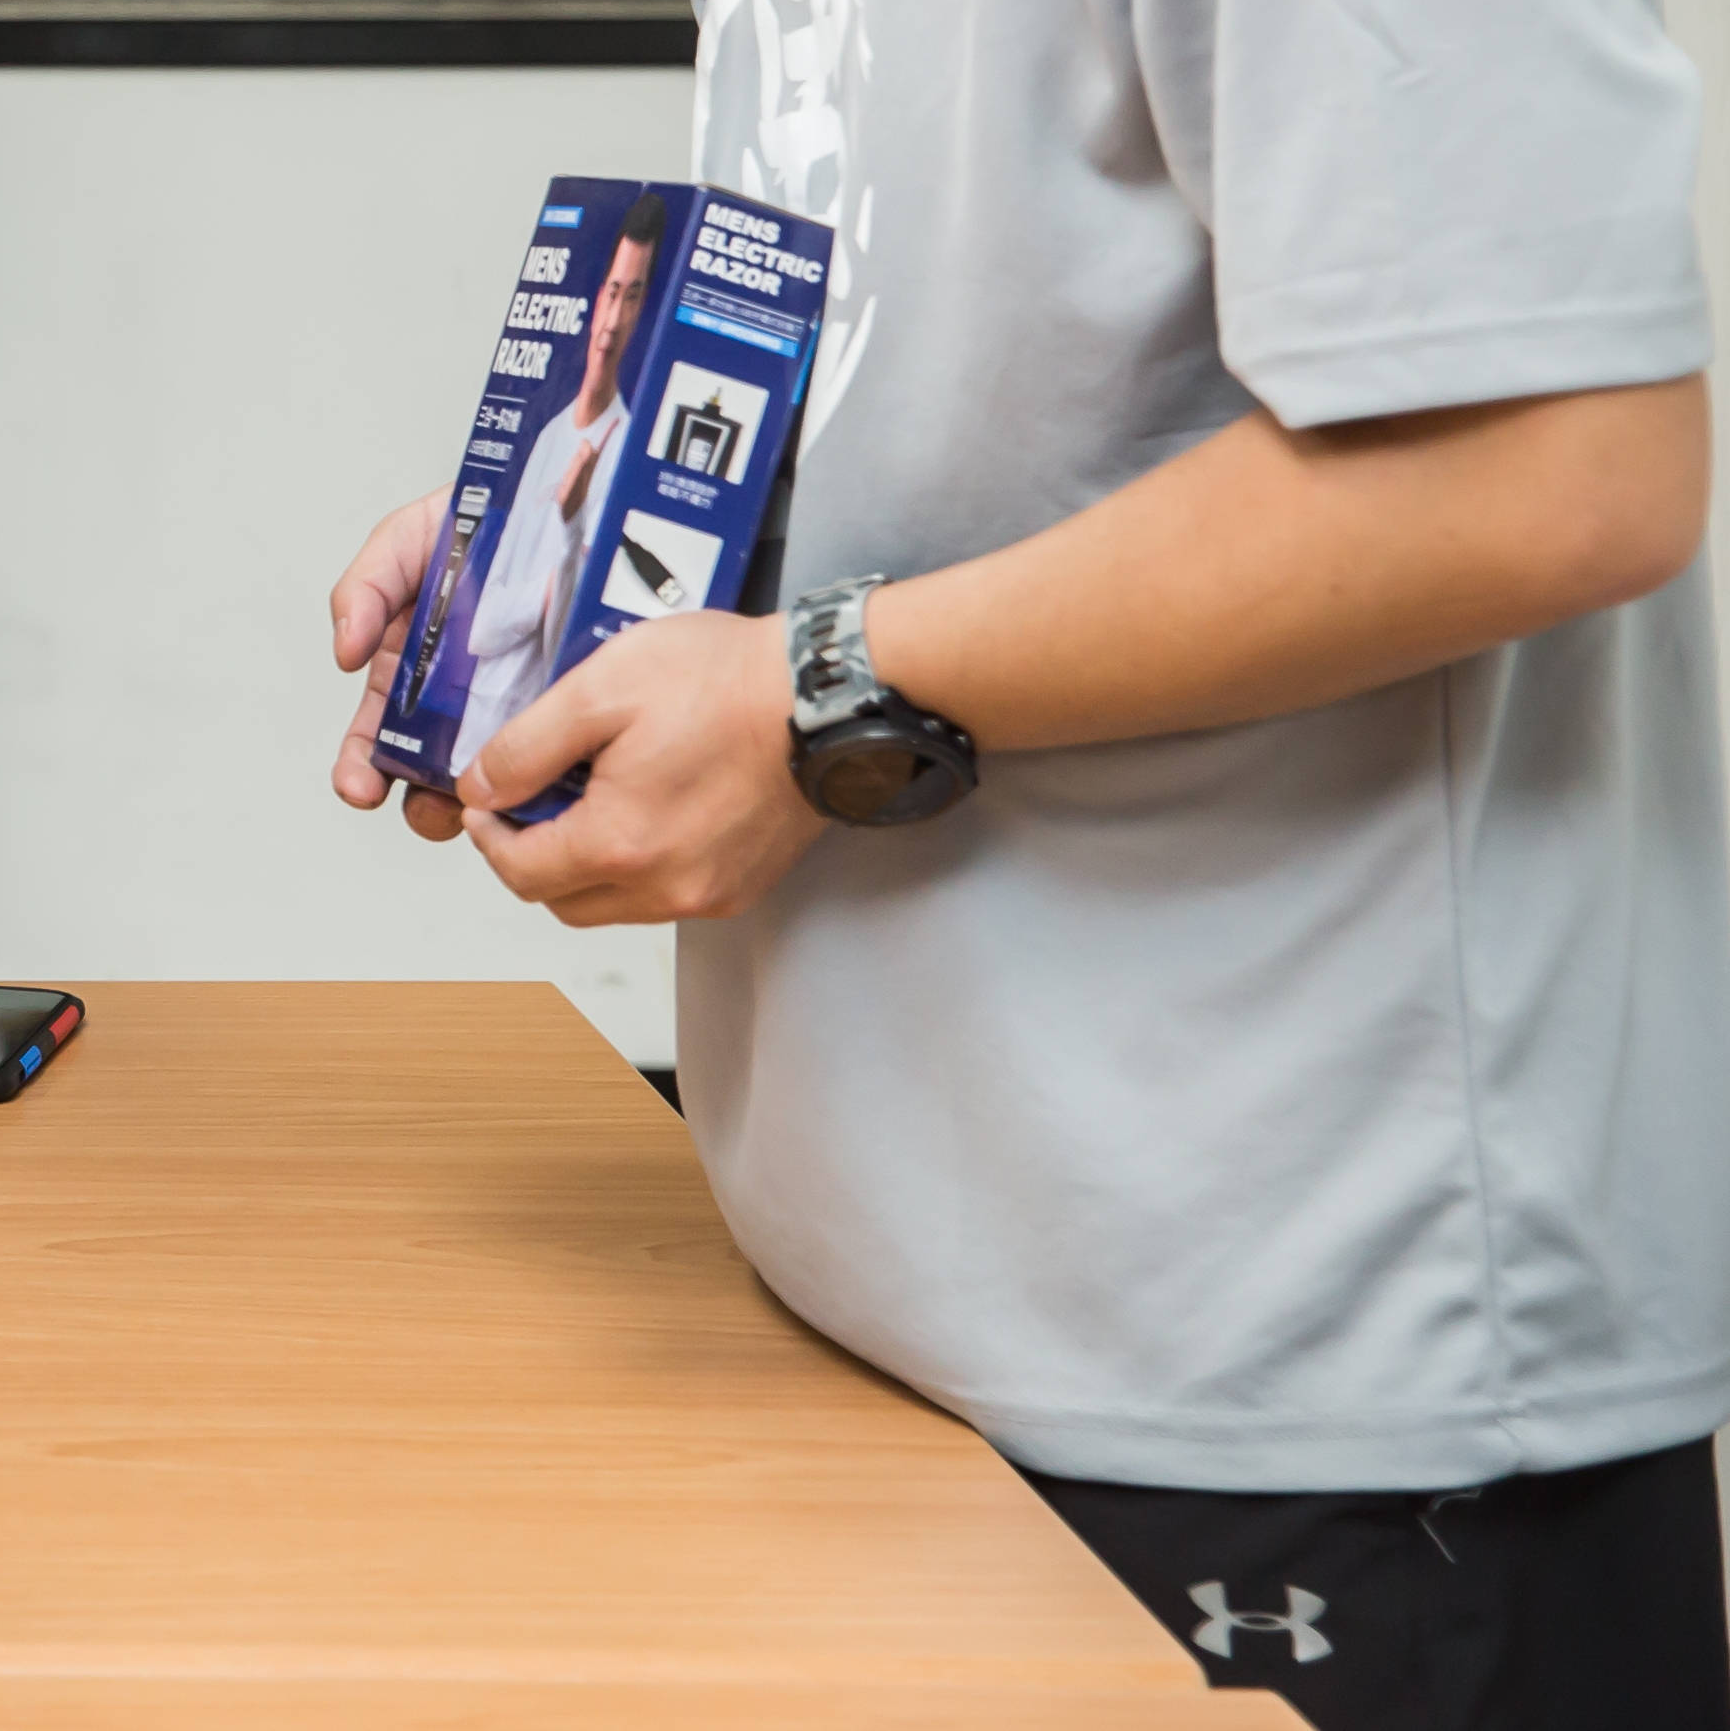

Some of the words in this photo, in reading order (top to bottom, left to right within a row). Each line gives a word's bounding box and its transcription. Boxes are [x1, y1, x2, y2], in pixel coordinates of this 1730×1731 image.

[704, 202, 781, 244] MENS
[521, 246, 571, 285] MENS
[690, 249, 782, 296] RAZOR
[697, 226, 824, 283] ELECTRIC
[507, 292, 588, 335] ELECTRIC
[492, 338, 553, 380] RAZOR
